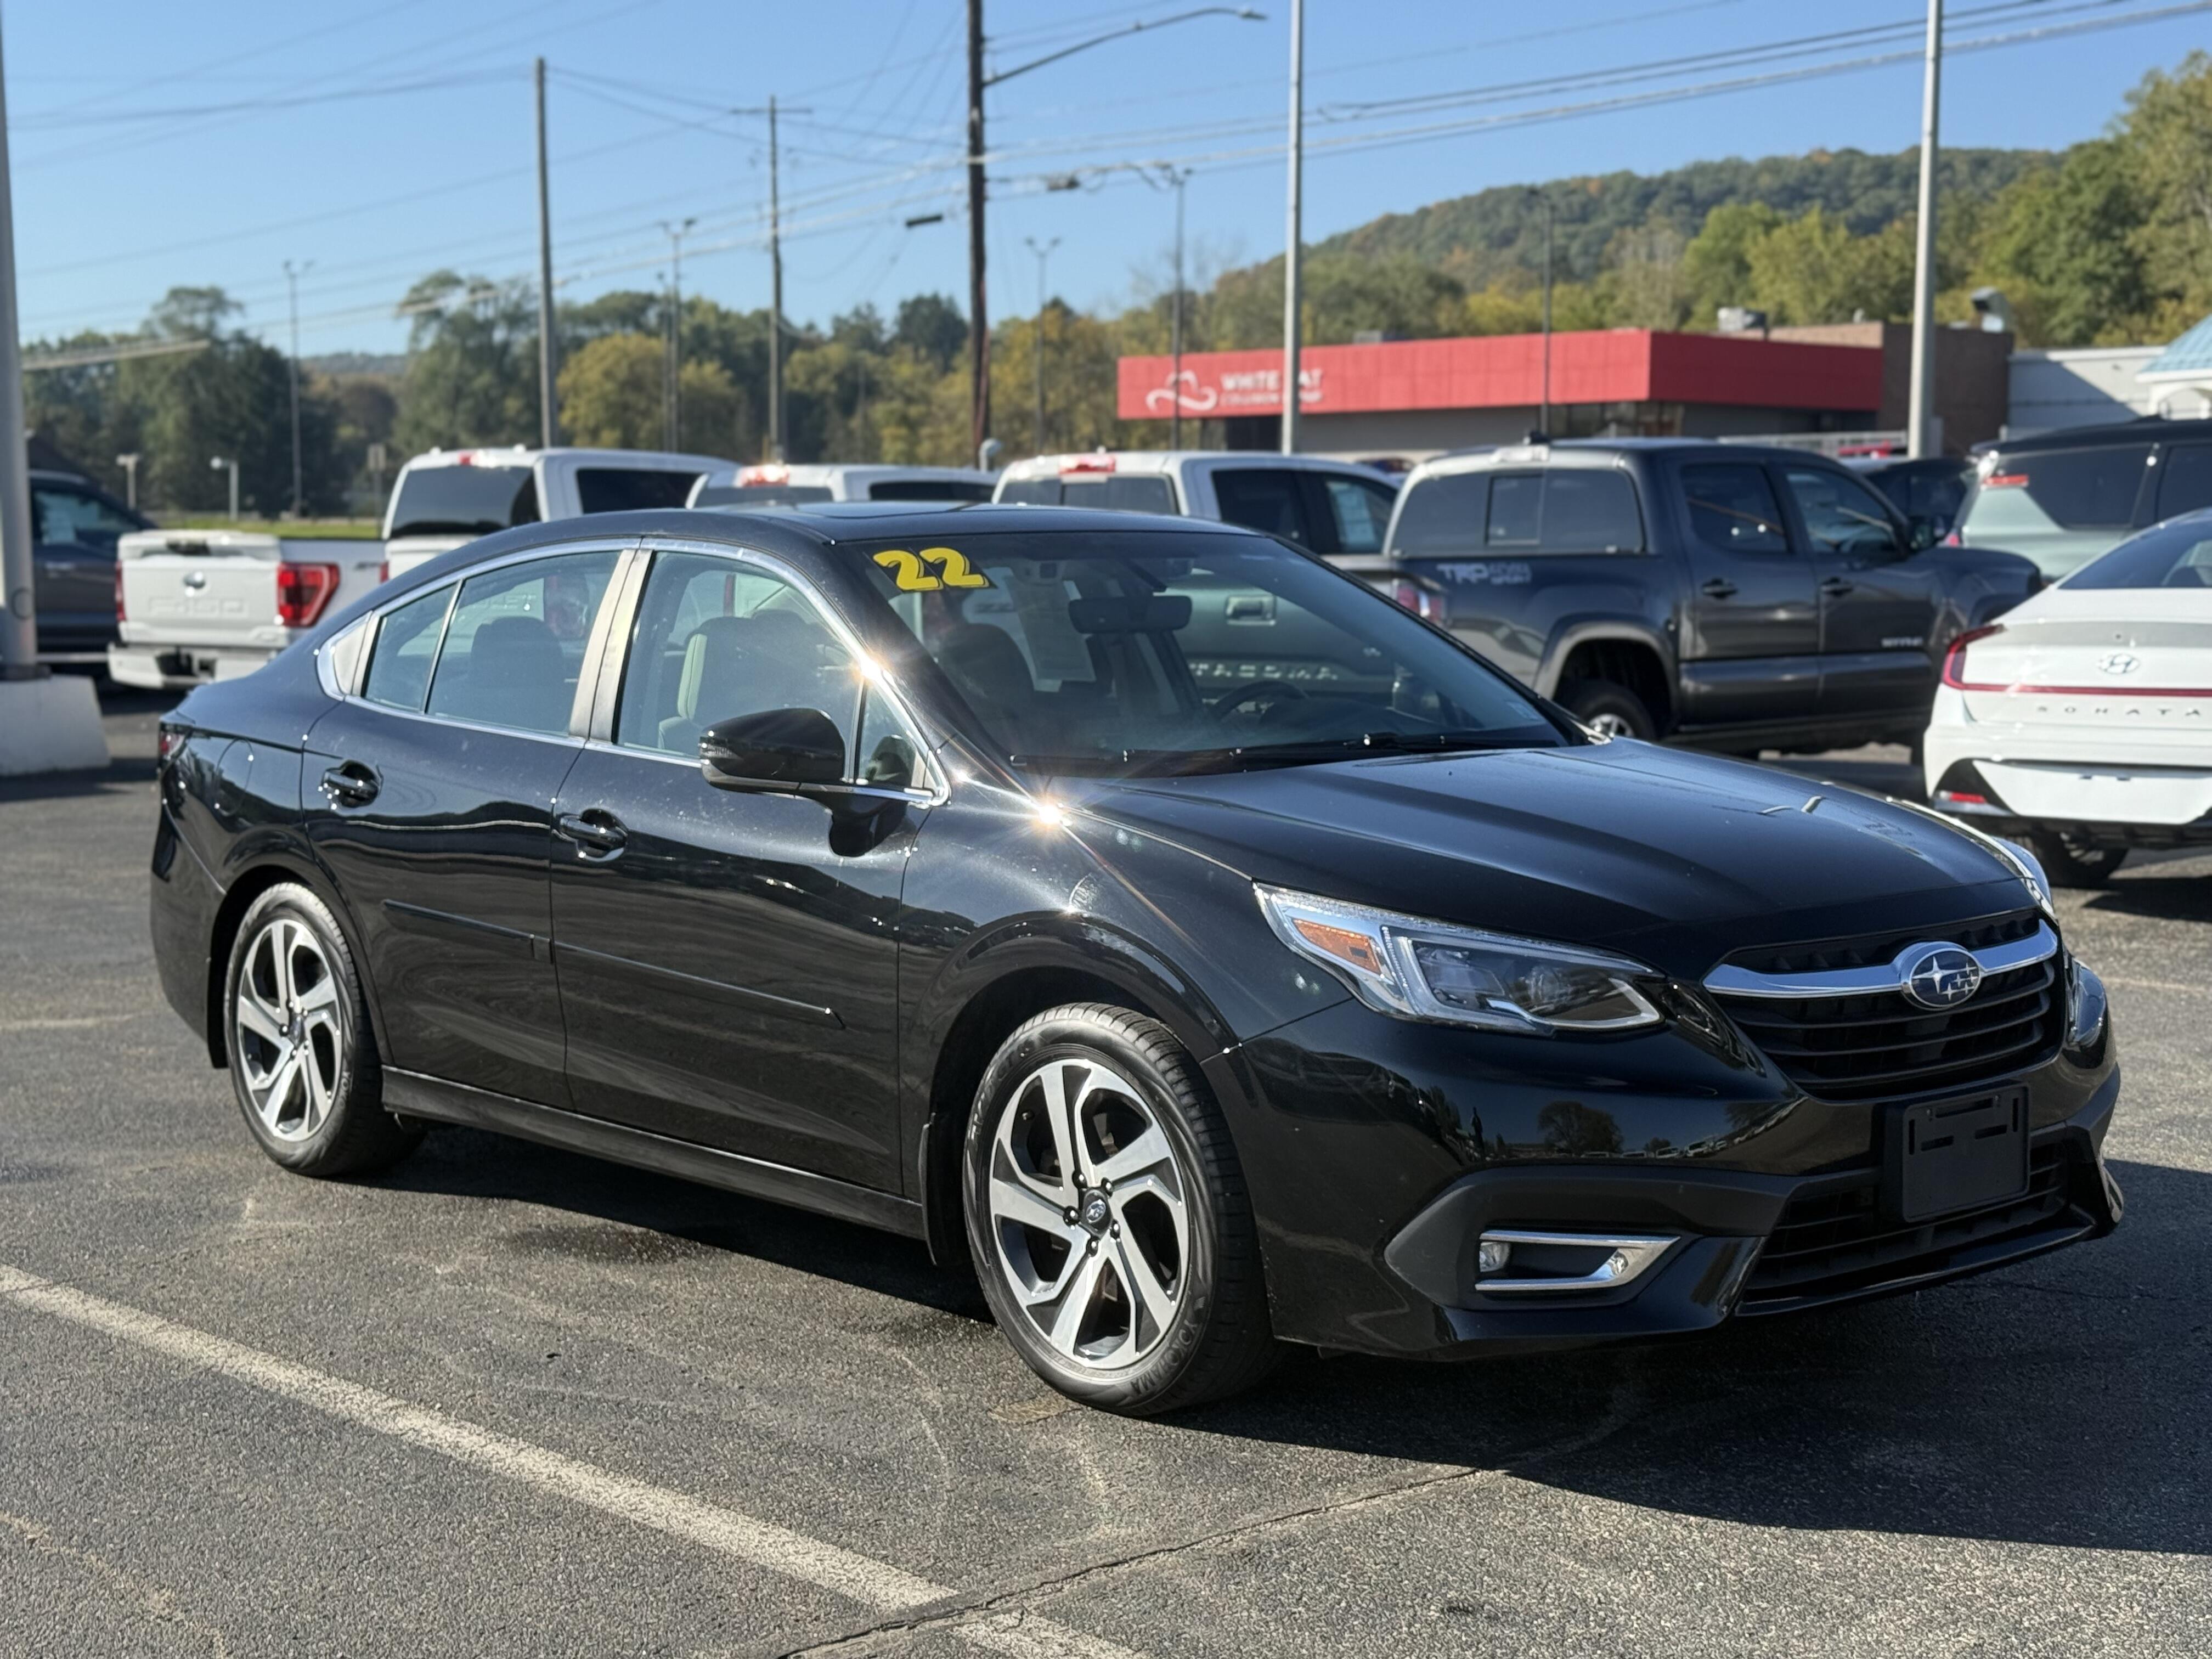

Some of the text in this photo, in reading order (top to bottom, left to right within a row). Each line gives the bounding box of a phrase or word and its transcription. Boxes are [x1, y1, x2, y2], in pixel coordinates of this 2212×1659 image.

[1220, 371, 1280, 391] WHITE
[873, 547, 990, 591] 22
[2037, 706, 2201, 716] SONATA
[1129, 1317, 1197, 1397] YOKOHAMA
